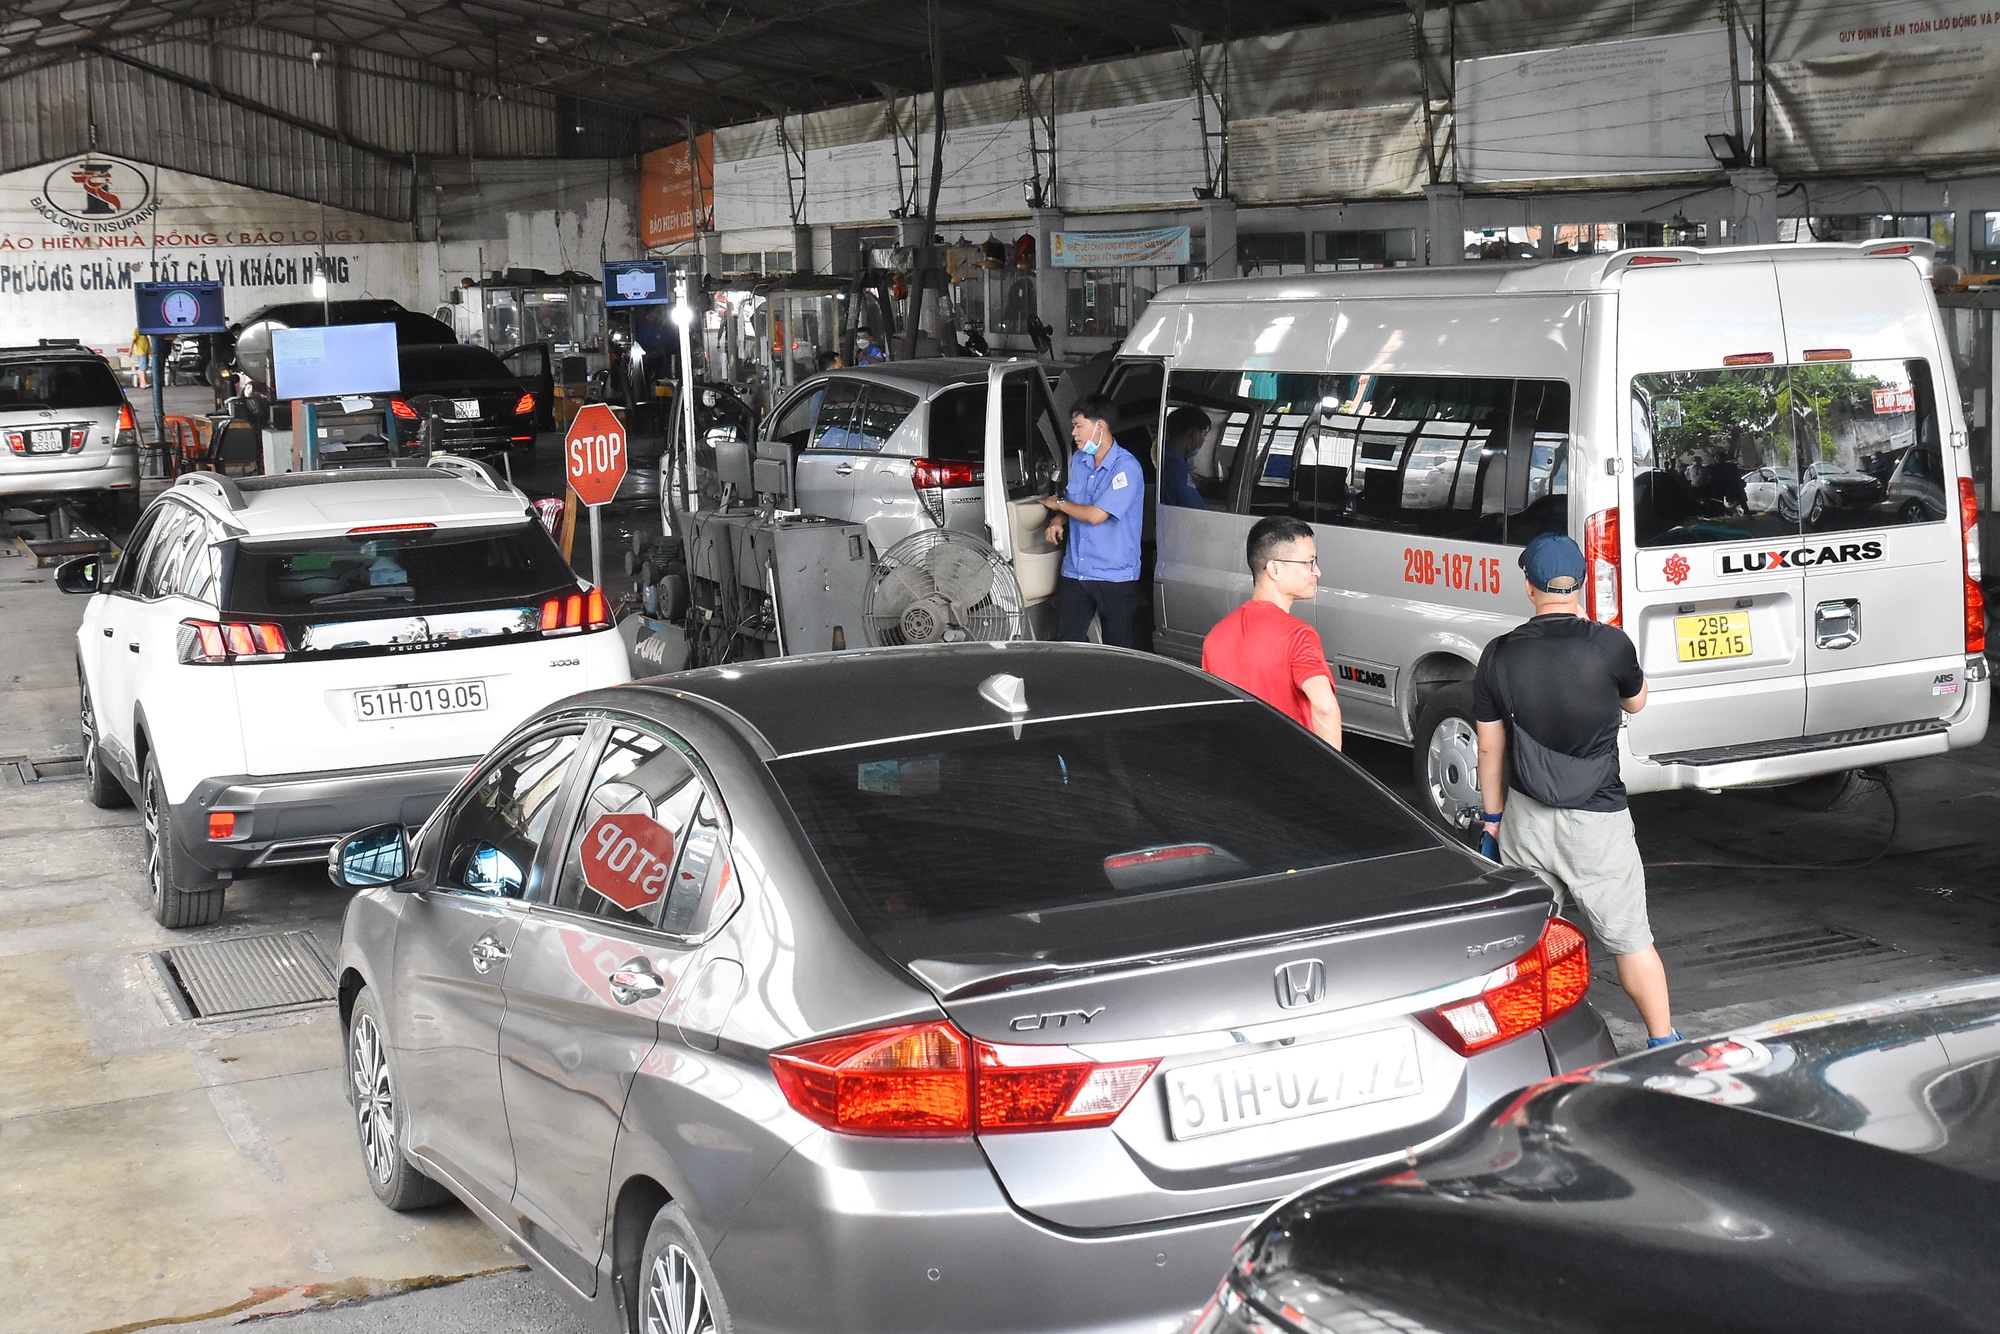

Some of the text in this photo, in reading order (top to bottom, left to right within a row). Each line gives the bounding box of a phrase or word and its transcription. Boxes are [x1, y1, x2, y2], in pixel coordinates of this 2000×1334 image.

[1893, 24, 1906, 36] AN
[1933, 17, 1950, 31] LAO
[30, 196, 164, 233] BAOLONG INSURANCE
[42, 231, 91, 249] HIỂM
[99, 231, 146, 248] NHÀ
[154, 228, 219, 247] RỒNG
[216, 255, 235, 286] VÌ
[240, 252, 298, 286] KHÁCH
[570, 432, 621, 477] STOP
[1404, 547, 1500, 595] 29B-187.15
[1722, 541, 1883, 574] LUXCARS
[389, 641, 448, 652] PEUGEOT
[1688, 635, 1744, 658] 187.15
[1933, 673, 1954, 684] ABS
[360, 684, 482, 716] 51H-019.05
[1009, 1006, 1106, 1032] CITY
